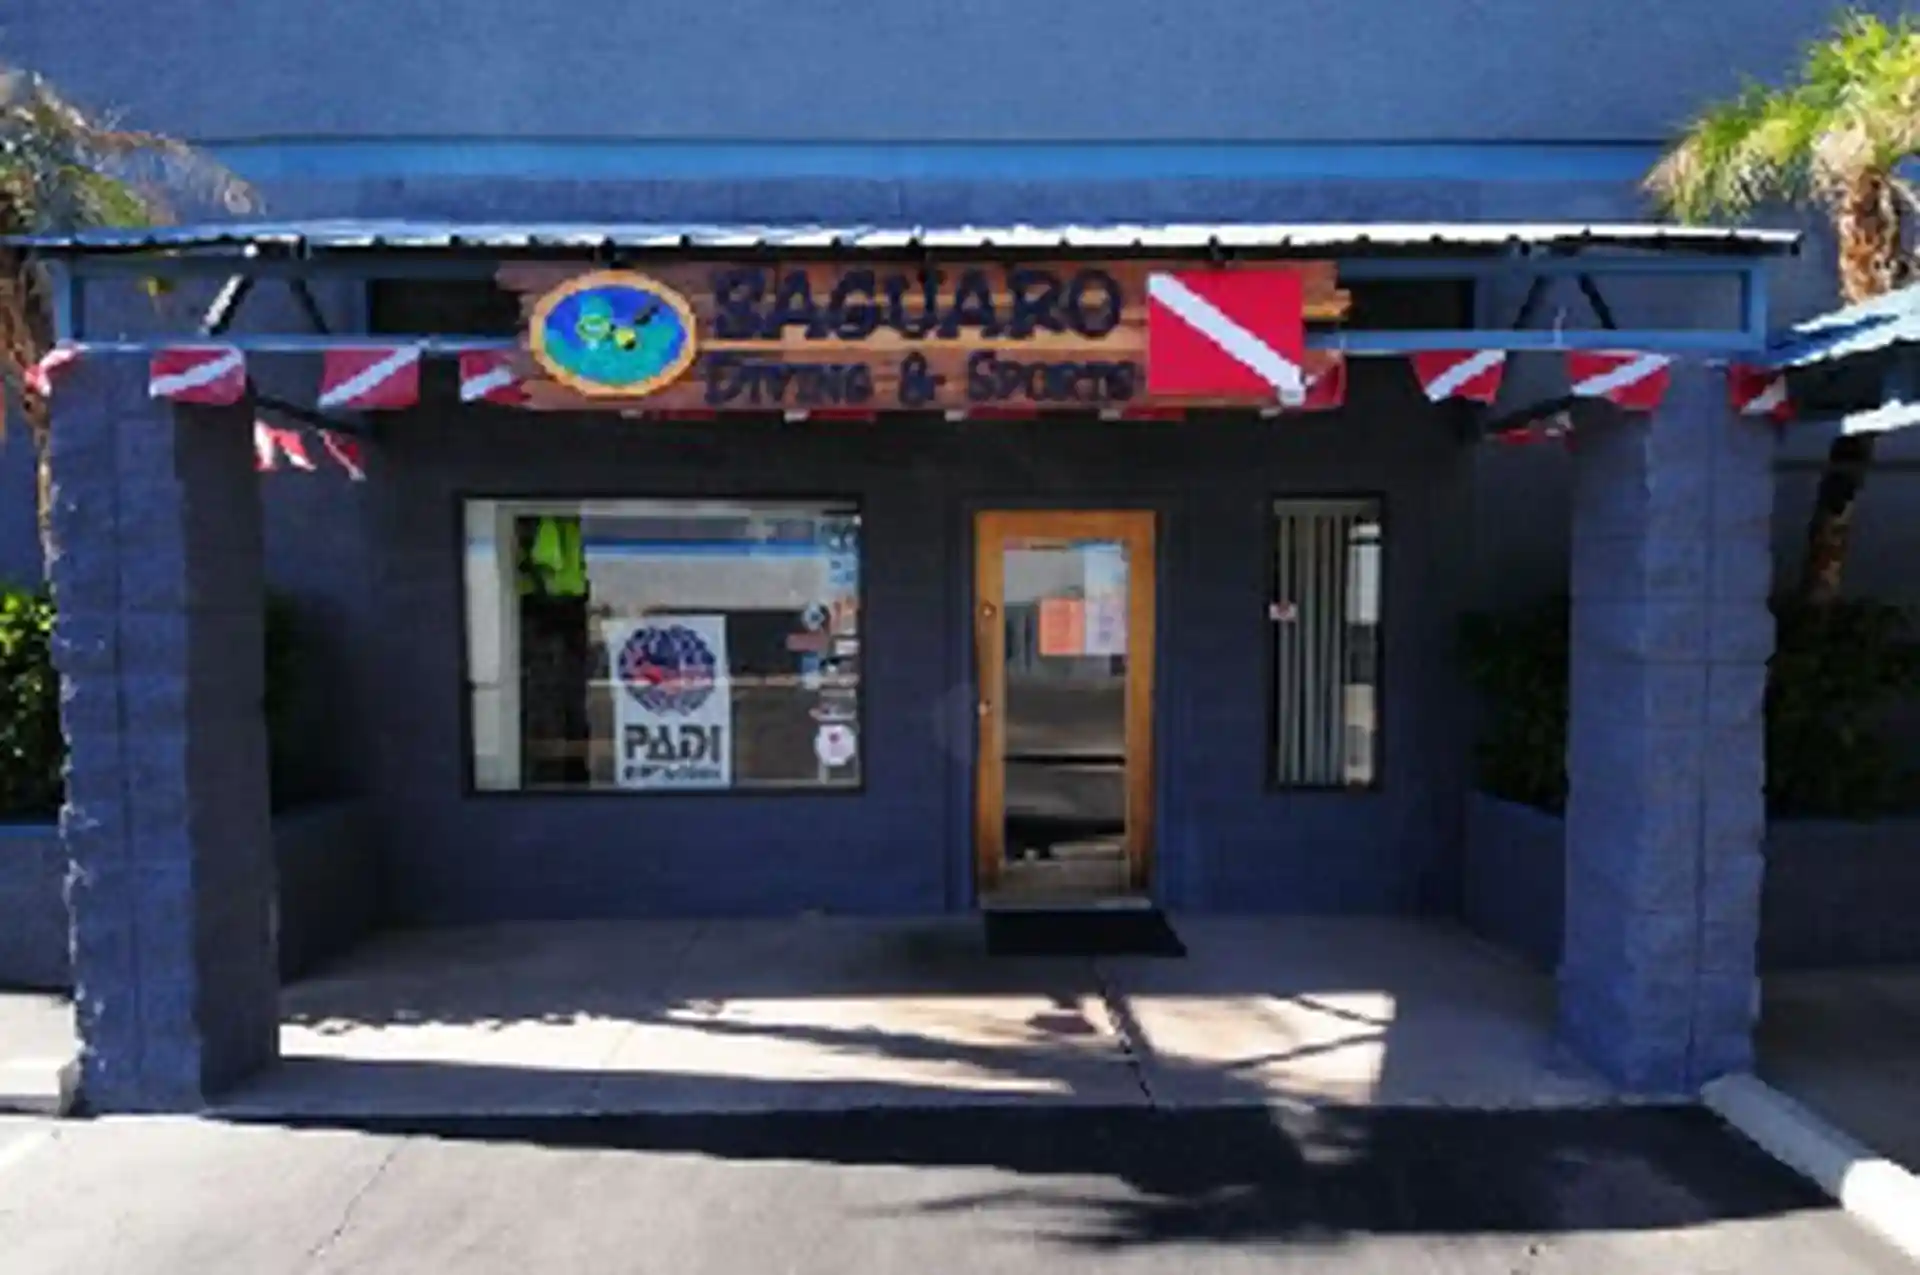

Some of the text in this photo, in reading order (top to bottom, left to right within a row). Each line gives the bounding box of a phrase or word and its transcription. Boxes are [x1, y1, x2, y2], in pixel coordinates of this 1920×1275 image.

[713, 266, 1122, 339] SAGUARO
[706, 351, 1139, 405] DIVING & SPORTS
[624, 724, 722, 763] PADI
